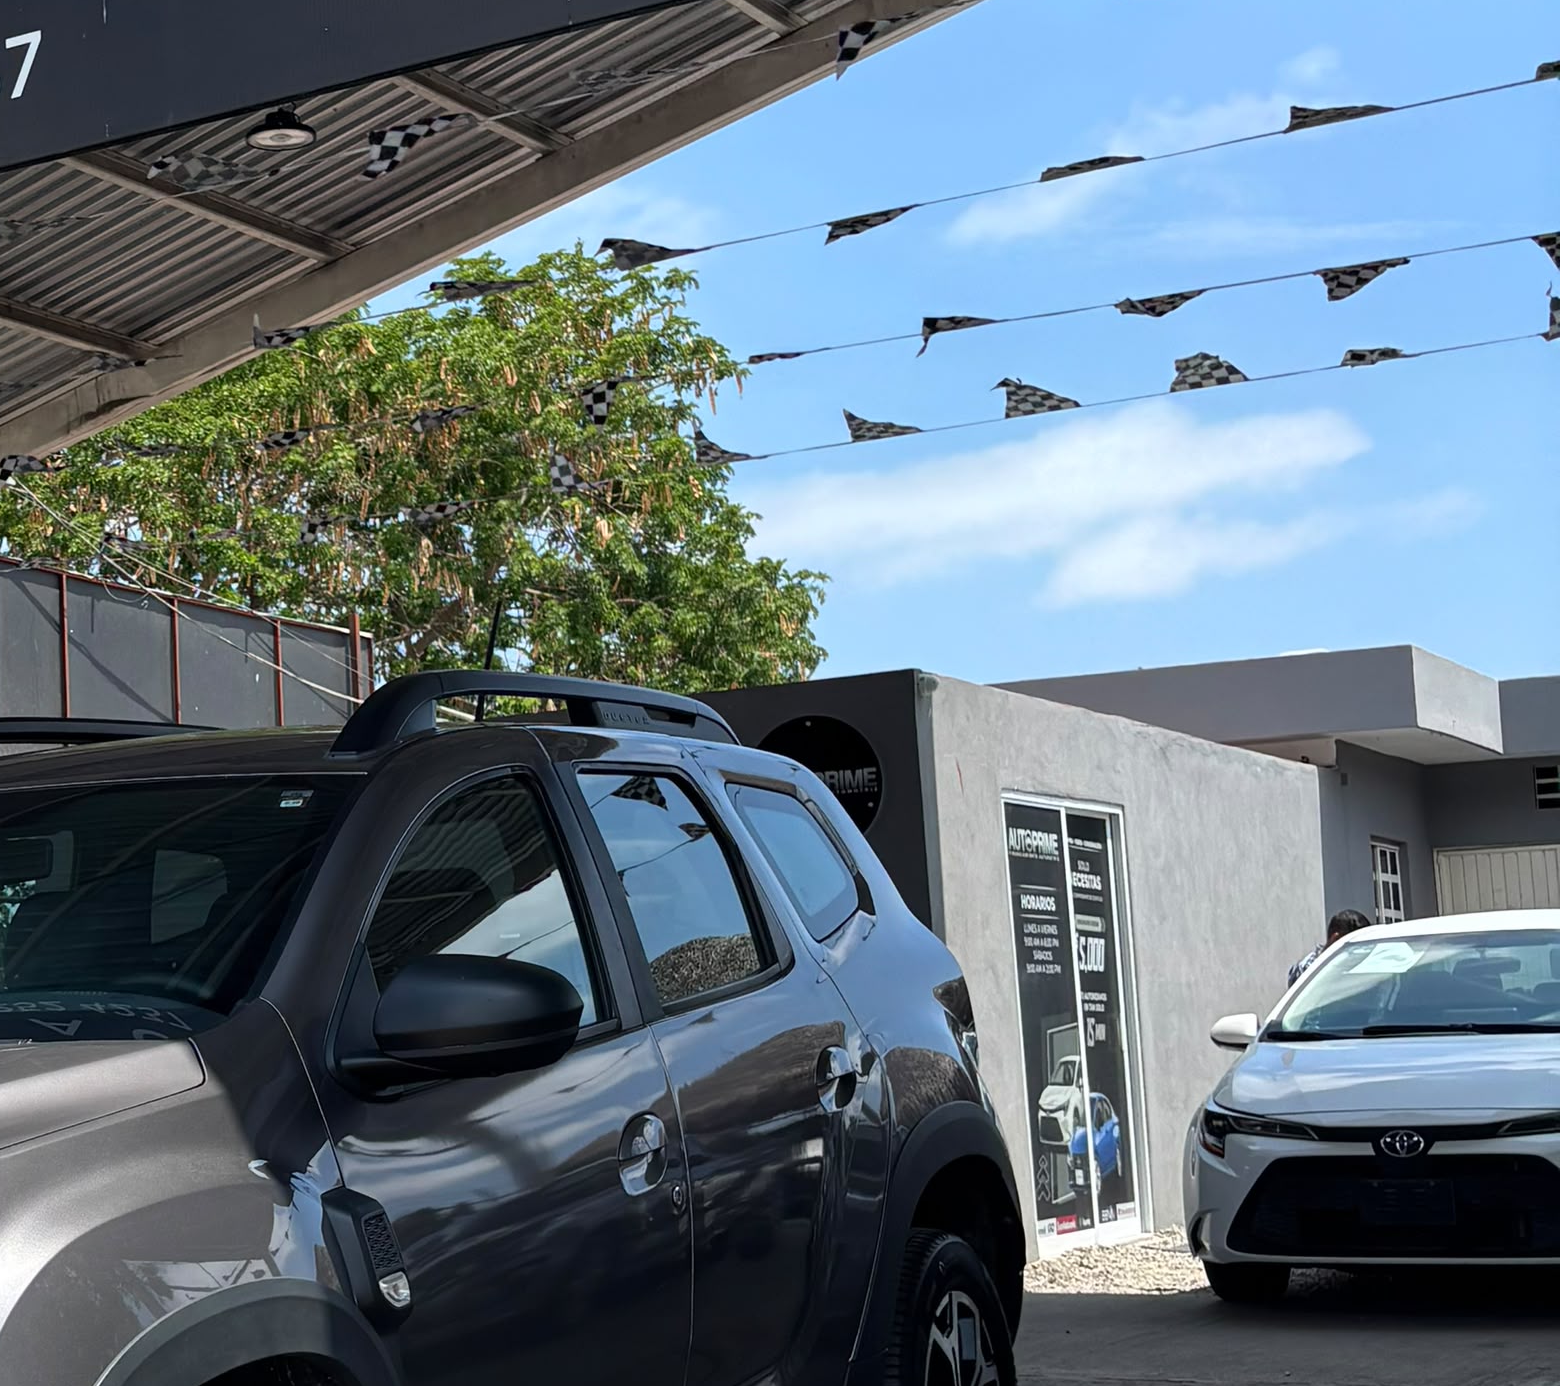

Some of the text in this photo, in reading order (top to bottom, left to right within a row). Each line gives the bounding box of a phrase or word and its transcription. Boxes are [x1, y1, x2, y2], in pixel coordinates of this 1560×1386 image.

[1008, 826, 1060, 856] AUTOPRIME
[1072, 872, 1102, 891] ECESITAS
[1020, 894, 1057, 912] HORARIOS
